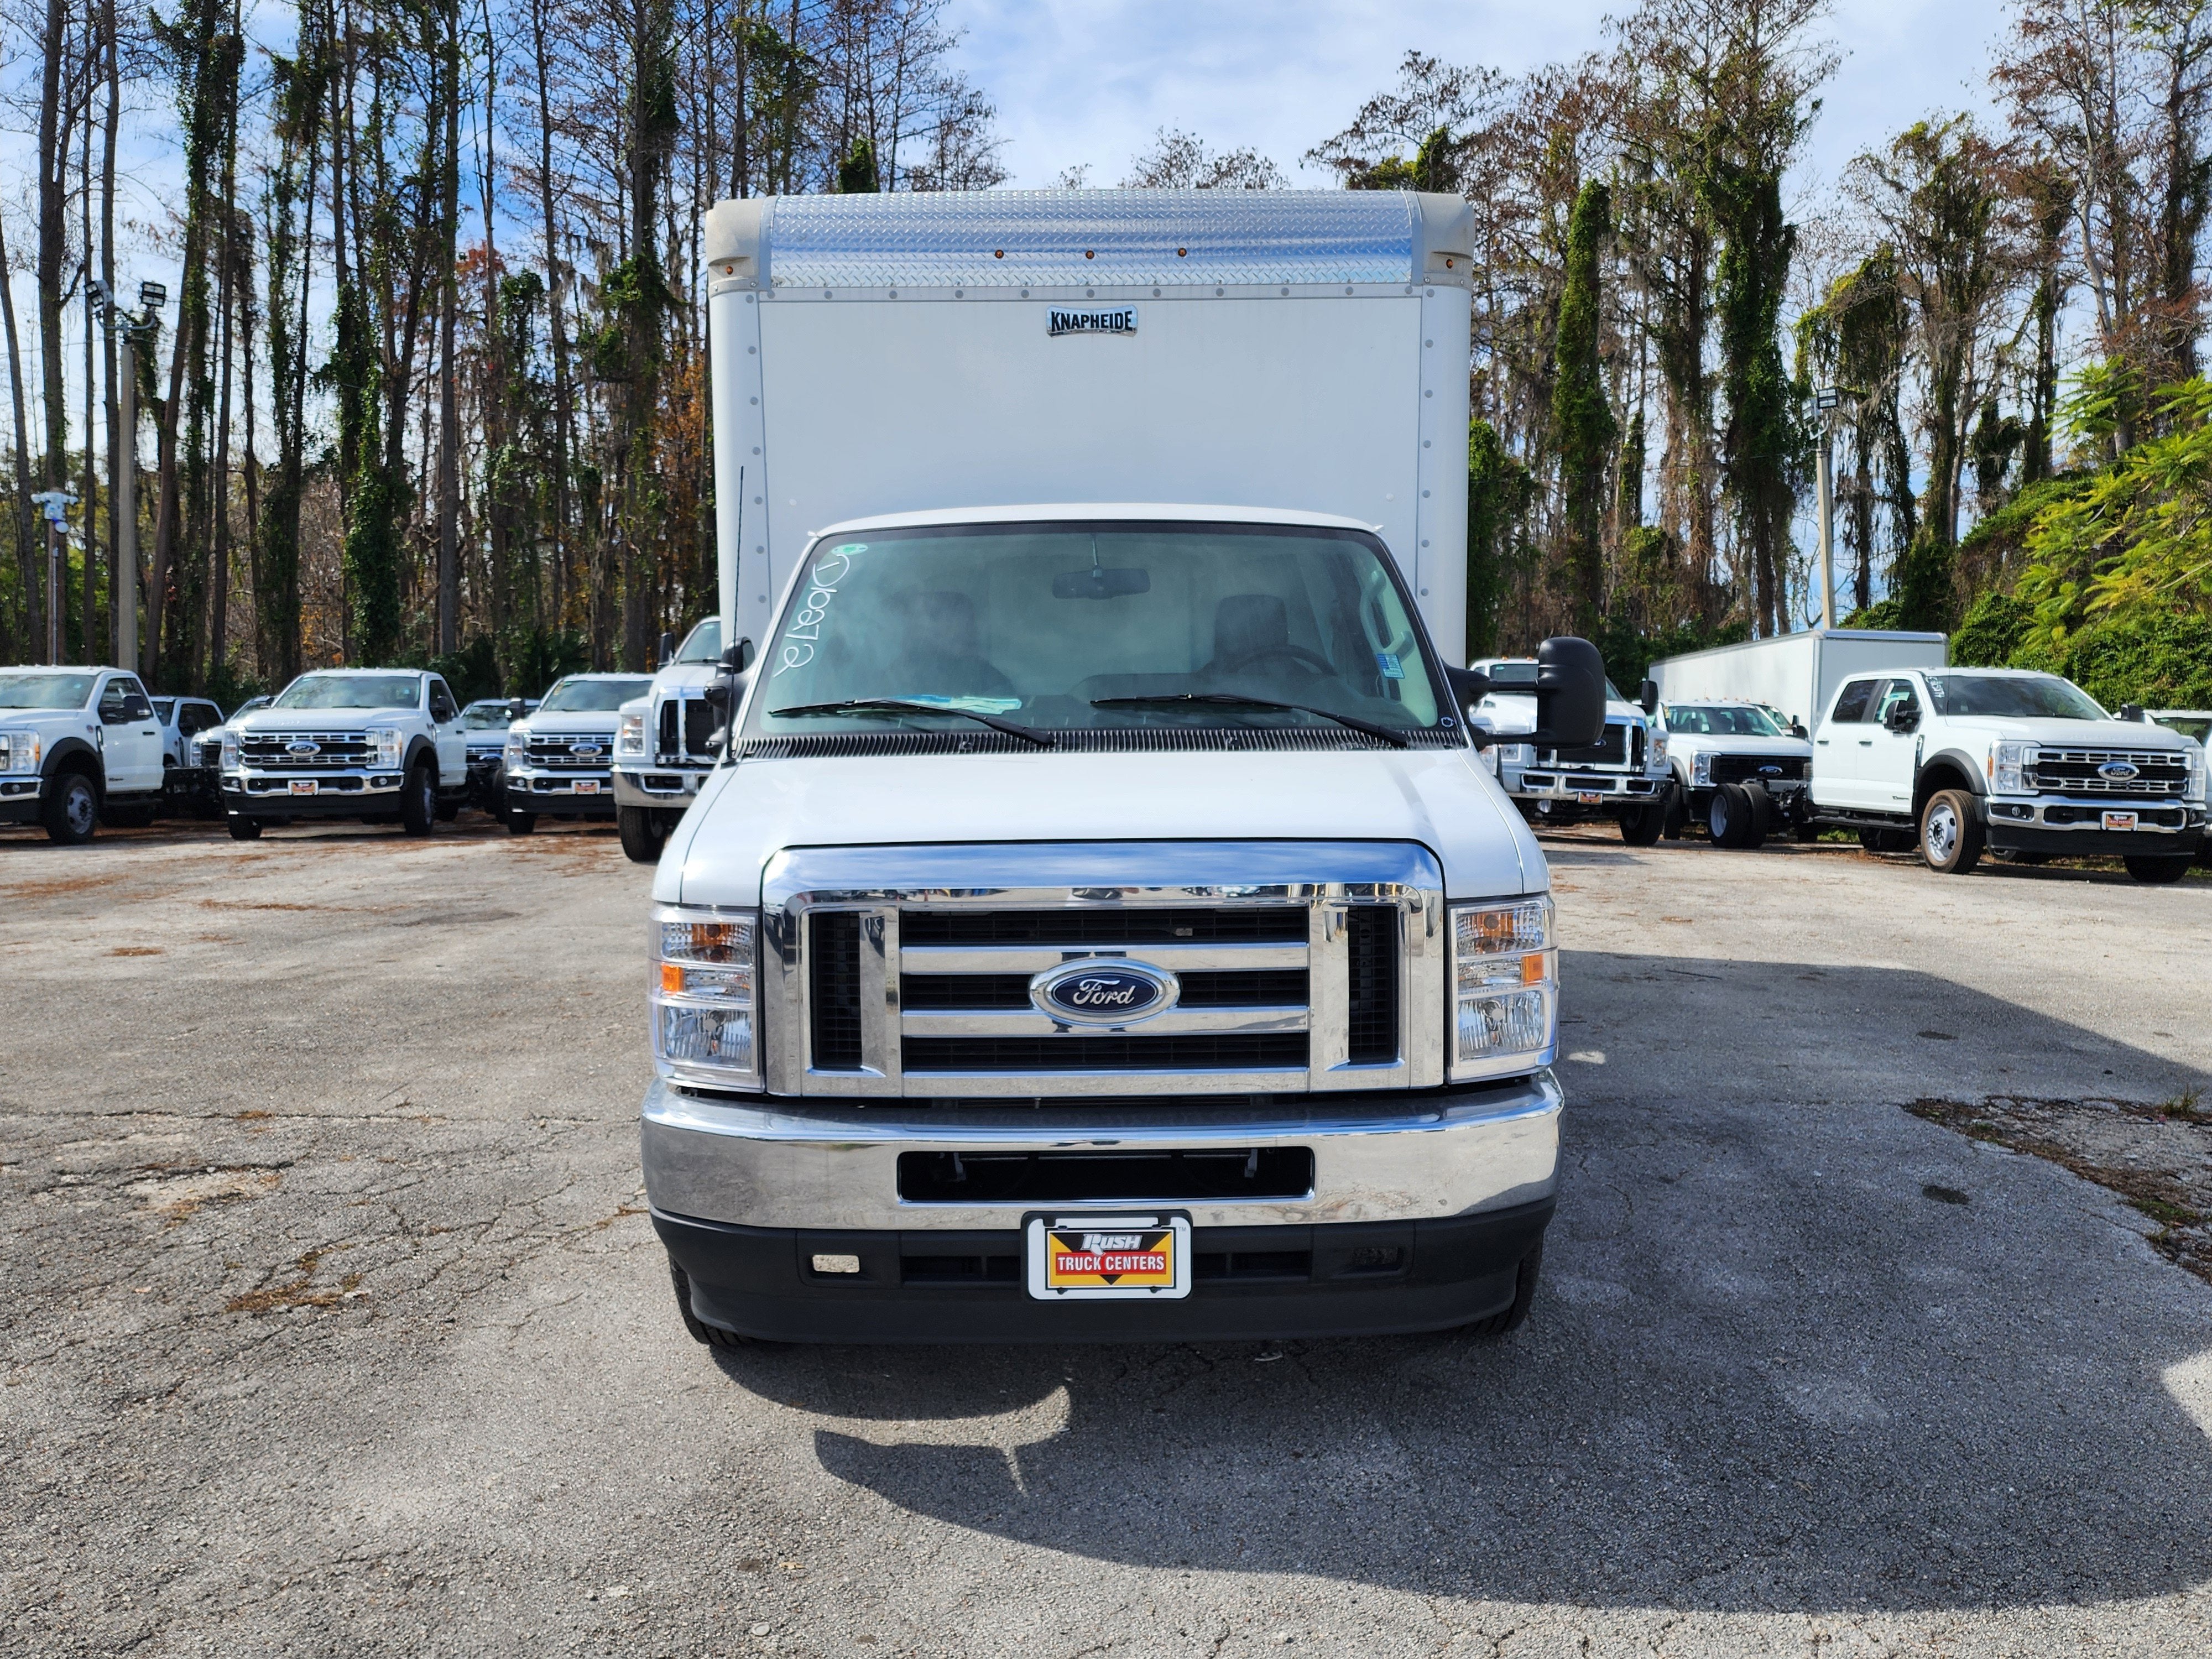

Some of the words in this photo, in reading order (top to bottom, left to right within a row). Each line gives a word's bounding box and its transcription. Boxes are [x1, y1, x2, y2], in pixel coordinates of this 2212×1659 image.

[1051, 310, 1133, 332] KNAPHEIDE
[1073, 979, 1135, 1004] Ford
[1057, 1257, 1102, 1271] TRUCK
[1106, 1256, 1165, 1270] CENTERS
